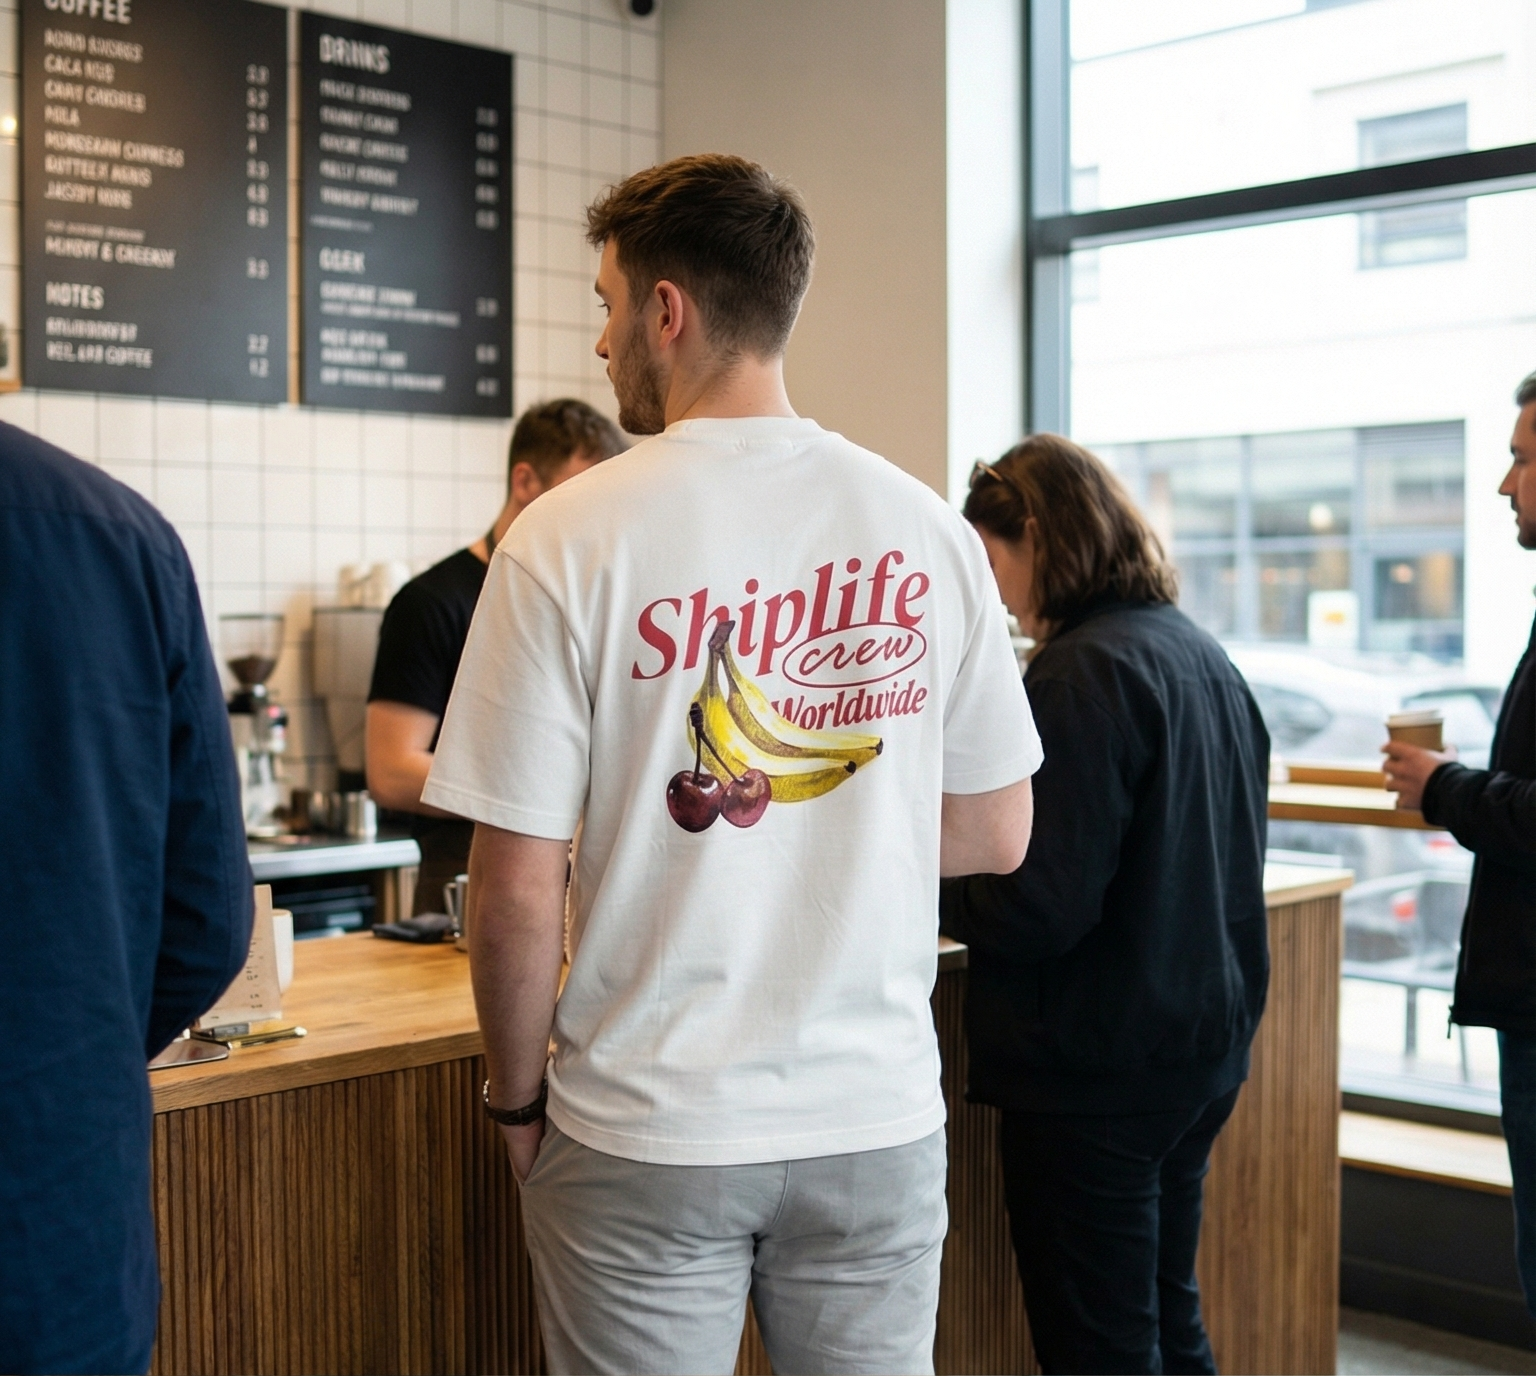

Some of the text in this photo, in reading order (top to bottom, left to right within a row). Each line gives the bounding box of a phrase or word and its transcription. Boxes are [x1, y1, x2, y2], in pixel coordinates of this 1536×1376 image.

[631, 549, 930, 680] Shiplife
[799, 633, 914, 676] crew
[770, 679, 928, 731] Worldwide
